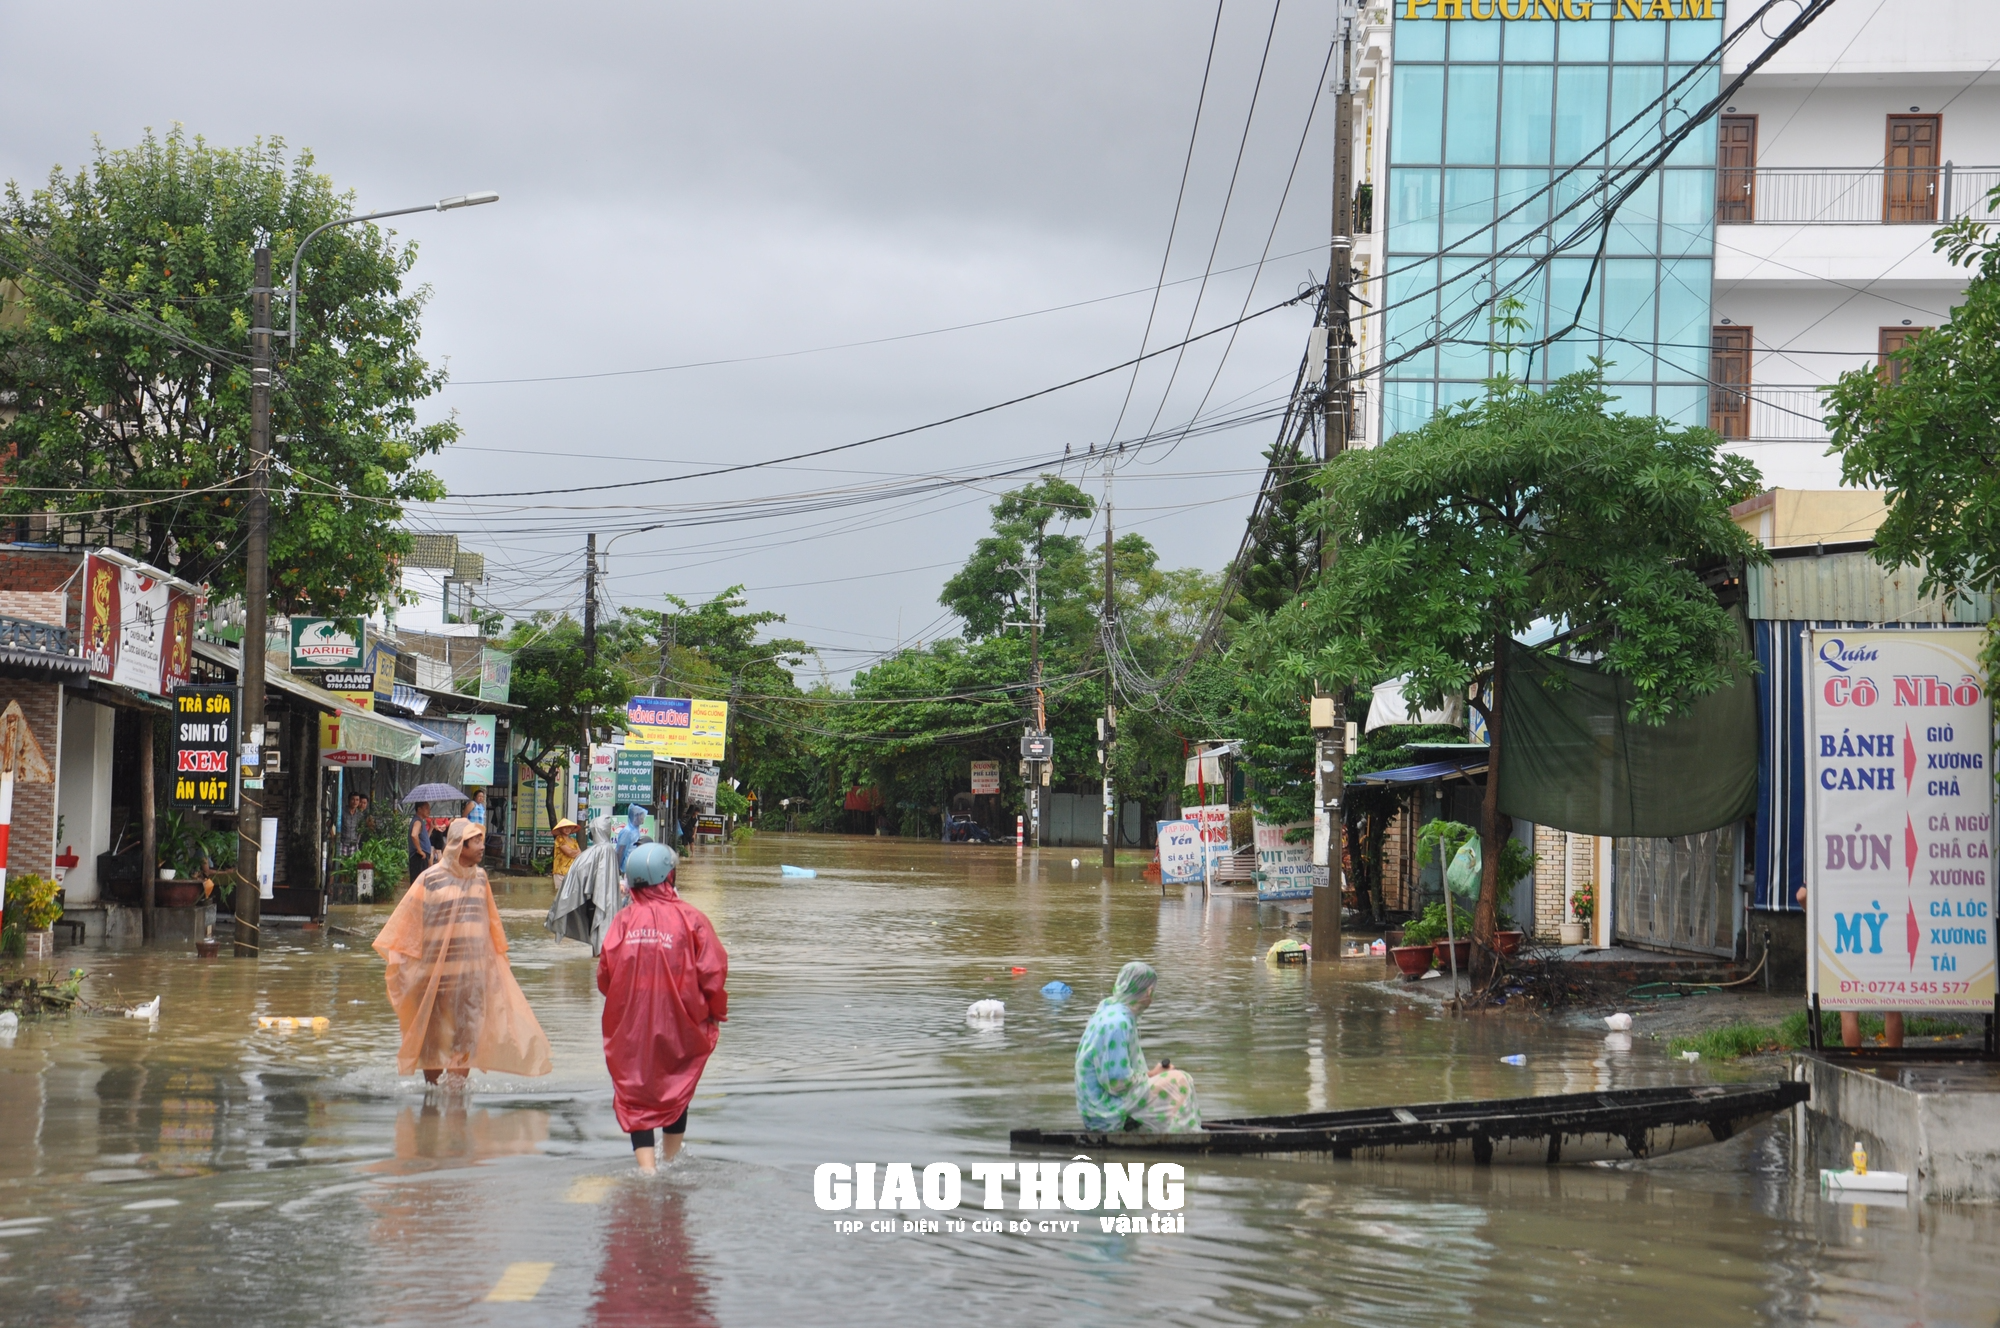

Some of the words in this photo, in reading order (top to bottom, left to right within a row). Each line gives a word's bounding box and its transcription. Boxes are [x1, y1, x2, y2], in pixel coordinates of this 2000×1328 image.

[1612, 0, 1716, 20] NAM
[302, 646, 353, 655] NARIHE
[1819, 639, 1879, 672] Quán
[326, 673, 371, 684] QUANG
[1824, 675, 1879, 707] Cô
[1892, 674, 1982, 707] Nhỏ
[179, 693, 202, 713] TRÀ
[206, 694, 230, 713] SỮA
[180, 723, 210, 742] SINH
[212, 718, 228, 742] TỐ
[1927, 723, 1954, 742] GIÒ
[486, 744, 491, 754] 7
[1820, 728, 1895, 757] BÁNH
[178, 750, 228, 772] KEM
[1927, 752, 1983, 769] XƯƠNG
[1820, 768, 1895, 791] CANH
[1928, 776, 1960, 796] CHẢ
[176, 776, 195, 799] ĂN
[199, 777, 227, 804] VẶT
[1928, 813, 1950, 832] CÁ
[1955, 812, 1990, 832] NGỪ
[1170, 833, 1192, 845] Yến
[1825, 823, 1892, 871] BÚN
[1262, 851, 1283, 864] VỊT
[1967, 840, 1989, 859] CÁ
[1279, 866, 1294, 874] HEO
[1929, 868, 1986, 886] XƯƠNG
[1930, 899, 1952, 917] CÁ
[1957, 899, 1988, 917] LÓC
[626, 929, 674, 943] AGRIBNK
[1834, 900, 1889, 954] MỲ
[1930, 927, 1987, 944] XƯƠNG
[1930, 953, 1956, 972] TÁI
[1840, 981, 1864, 993] ĐT:
[1868, 981, 1906, 993] 0774
[1910, 982, 1938, 993] 545
[1942, 982, 1970, 994] 577
